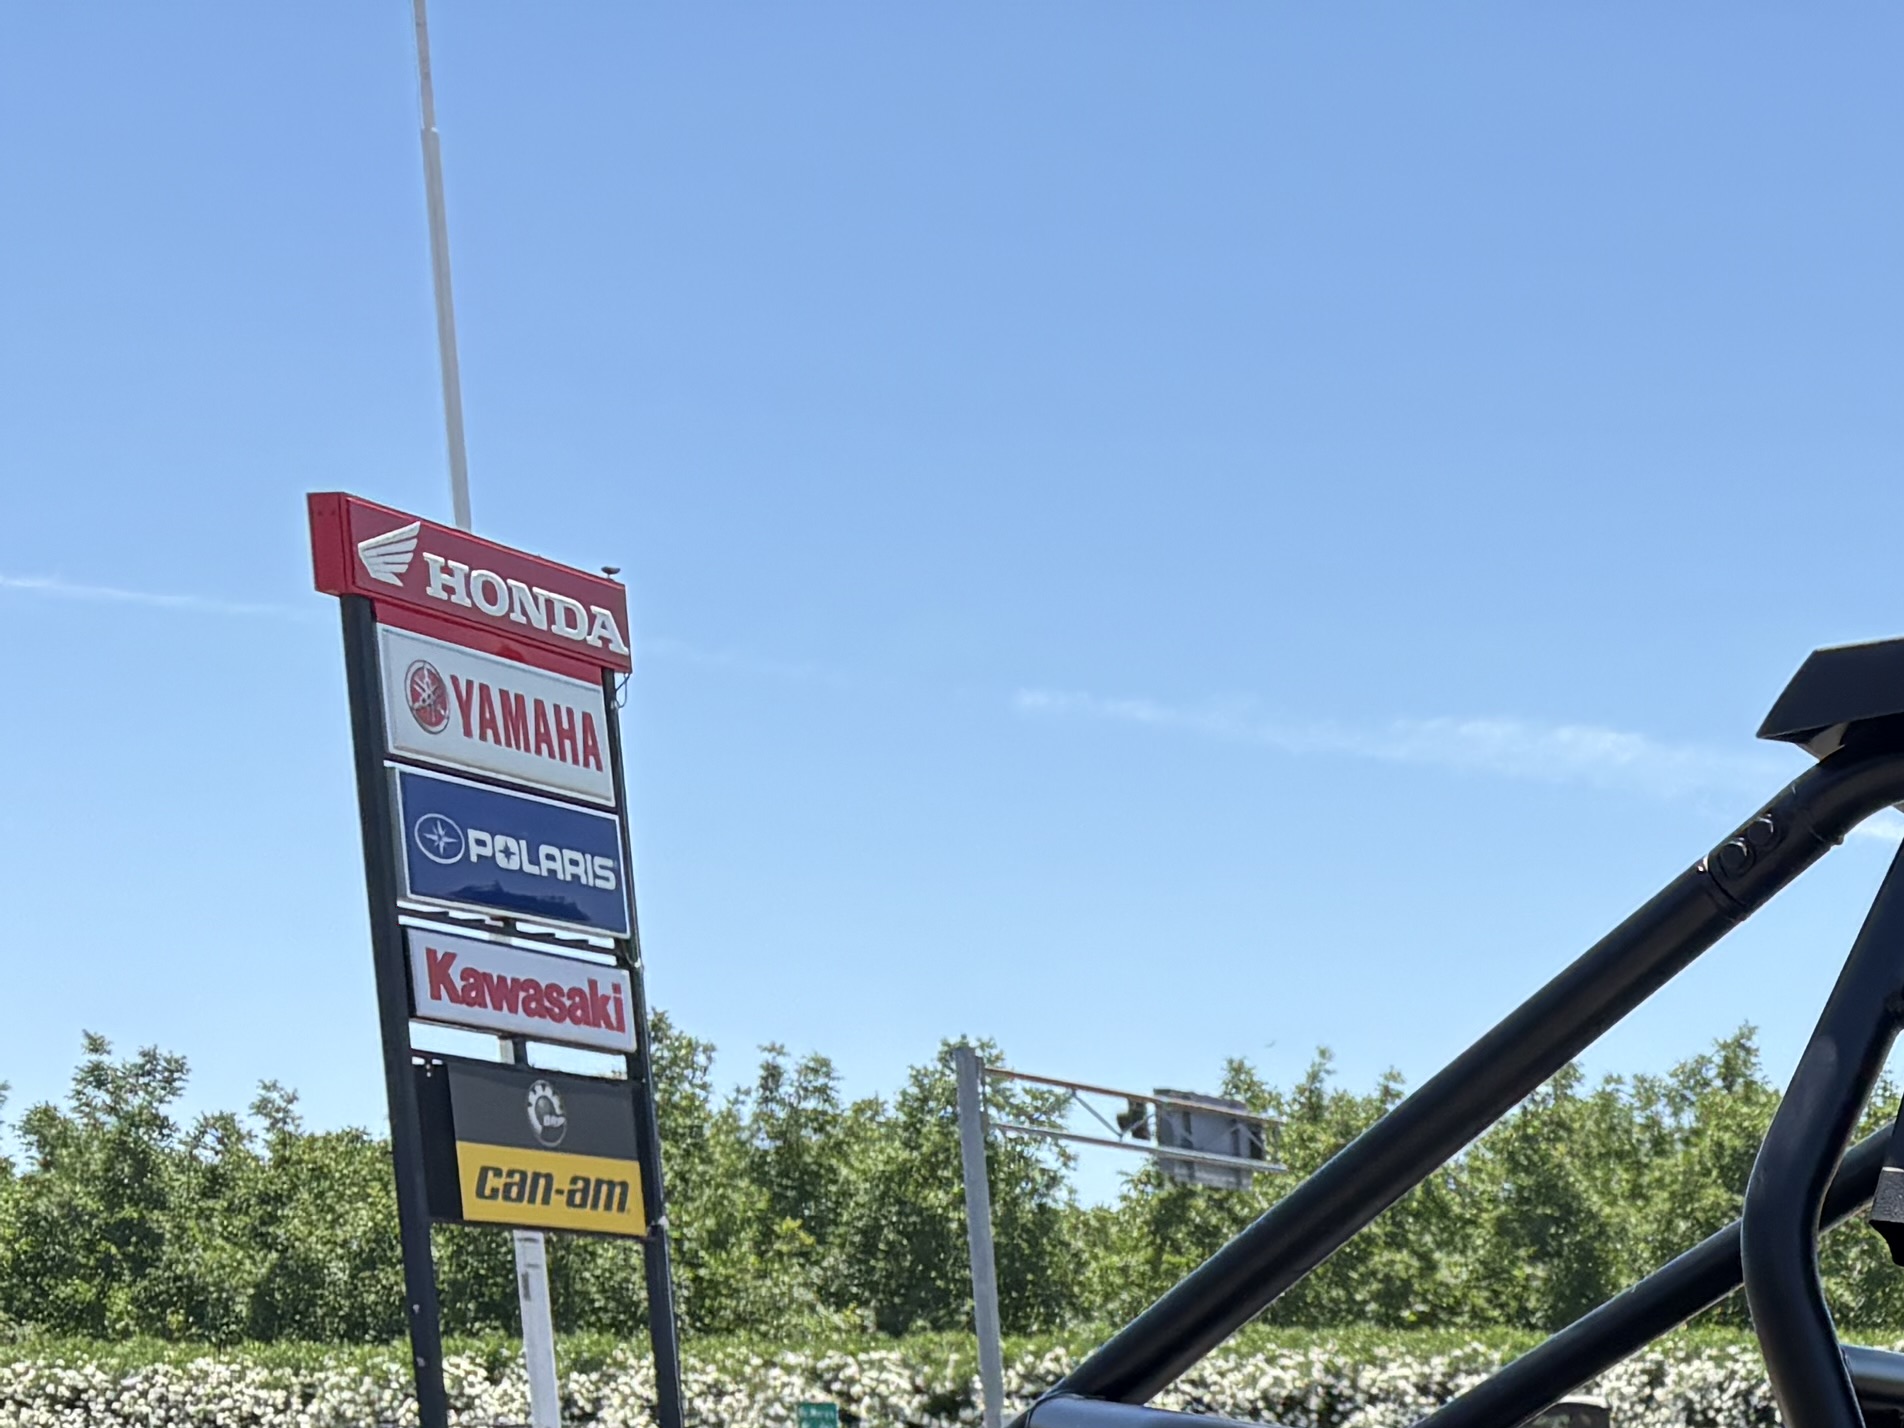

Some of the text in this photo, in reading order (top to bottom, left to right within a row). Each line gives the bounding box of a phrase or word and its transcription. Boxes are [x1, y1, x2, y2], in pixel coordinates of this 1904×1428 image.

[422, 551, 630, 656] HONDA
[450, 673, 604, 773] YAMAHA
[467, 828, 617, 890] POLARIS
[424, 946, 627, 1035] Kawasaki
[474, 1164, 630, 1215] can-am
